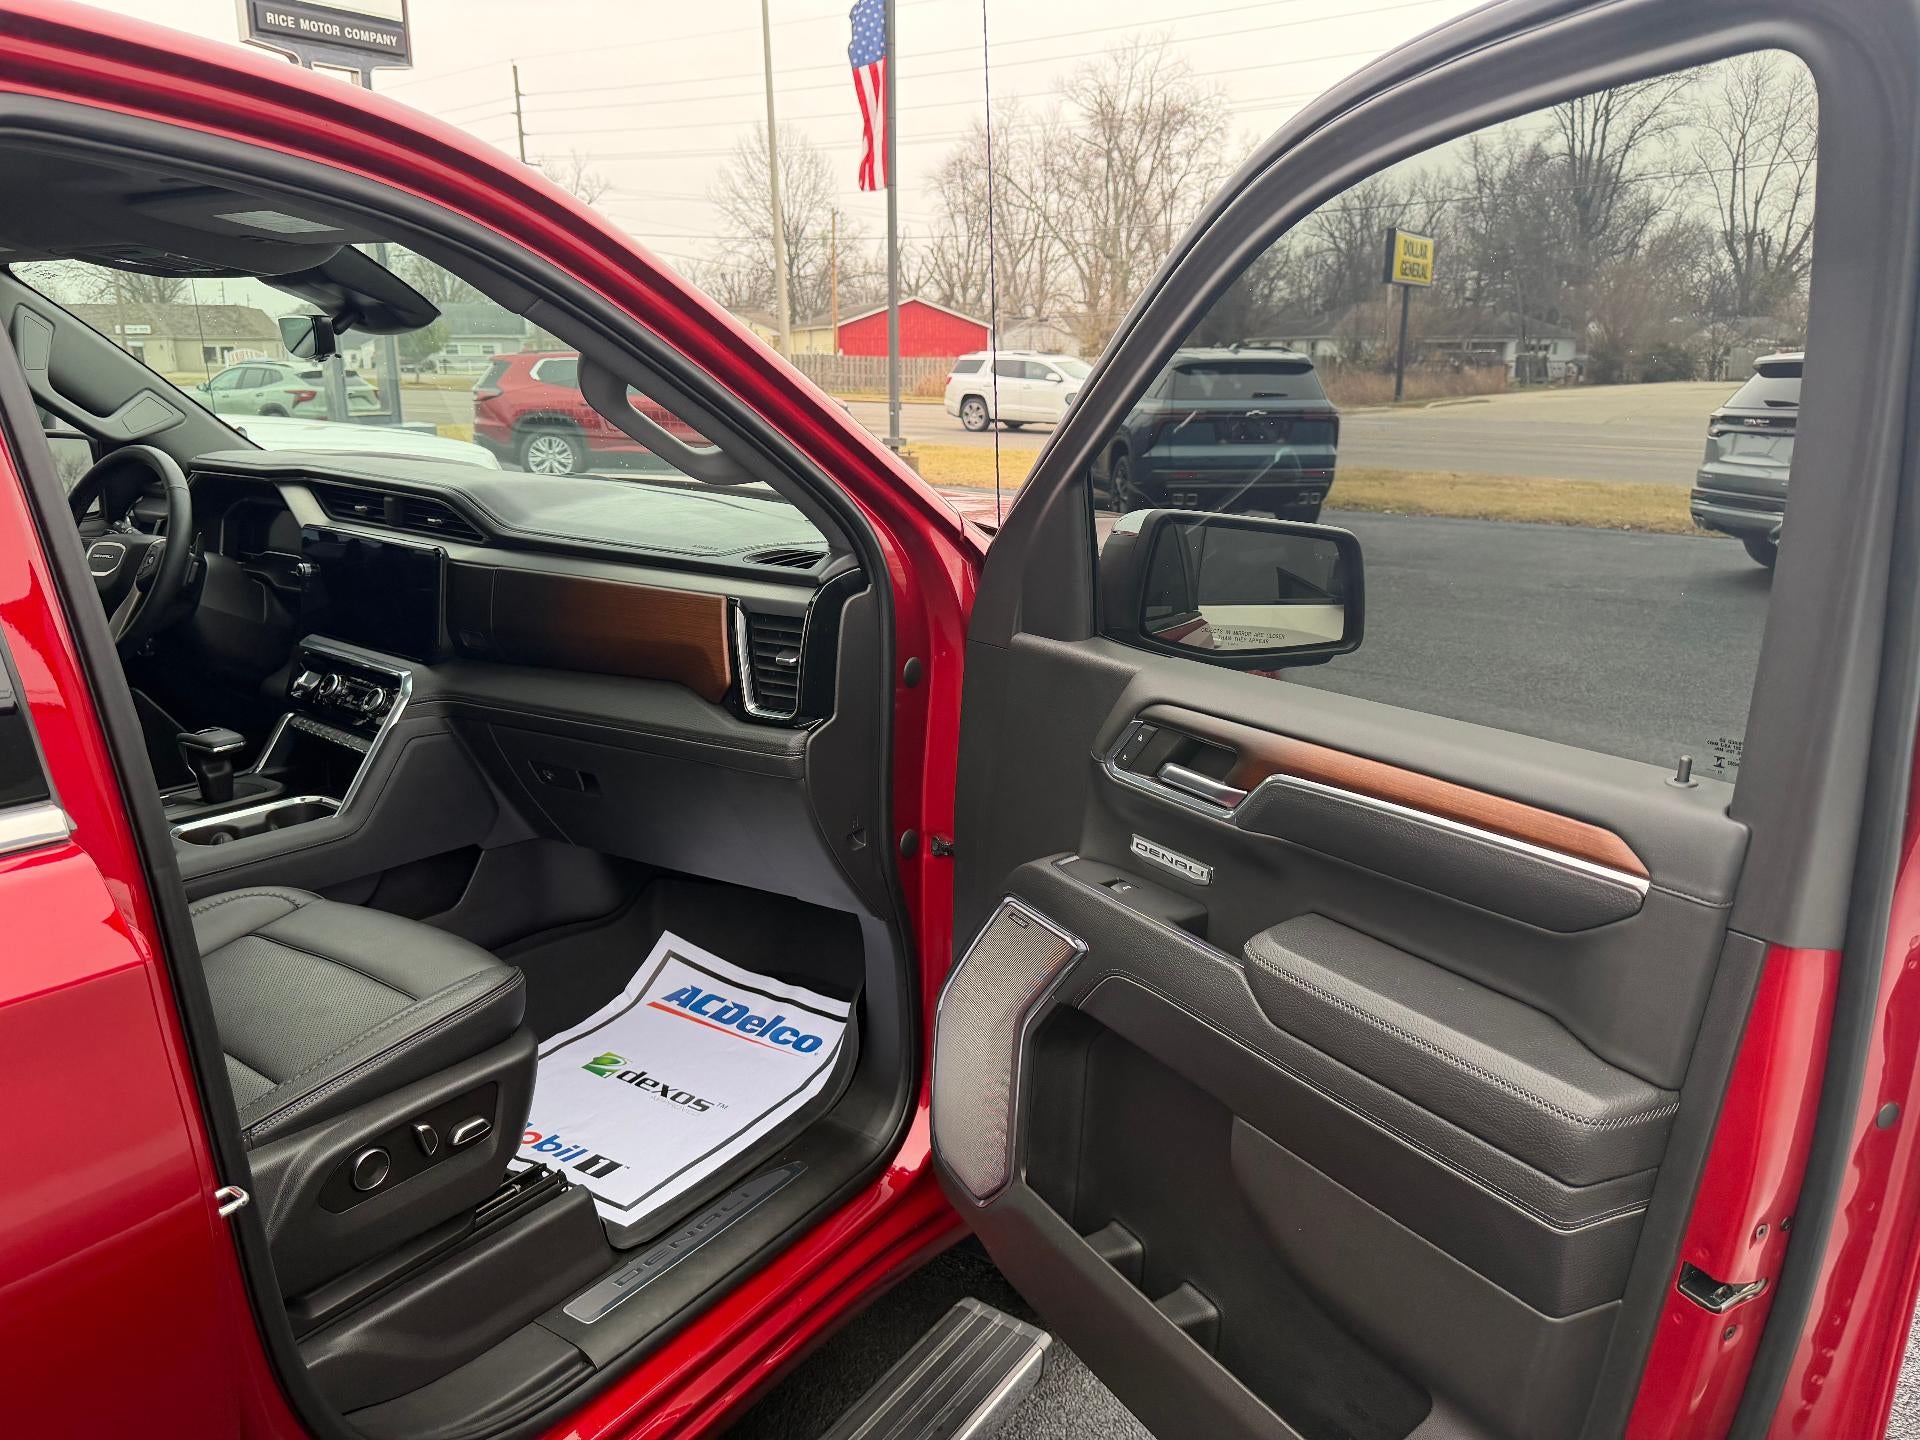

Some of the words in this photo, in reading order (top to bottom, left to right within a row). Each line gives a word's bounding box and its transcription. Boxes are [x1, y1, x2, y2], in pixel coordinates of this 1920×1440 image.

[265, 12, 295, 29] RICE
[299, 19, 341, 37] MOTOR
[344, 27, 398, 47] COMPANY
[1403, 239, 1428, 259] DOLLAR
[1400, 260, 1428, 280] GENERAL
[1135, 841, 1205, 878] DENALI
[661, 985, 823, 1053] ACDelco
[616, 1070, 715, 1112] dexos
[521, 1123, 590, 1163] obil
[611, 1190, 751, 1288] DENALI
